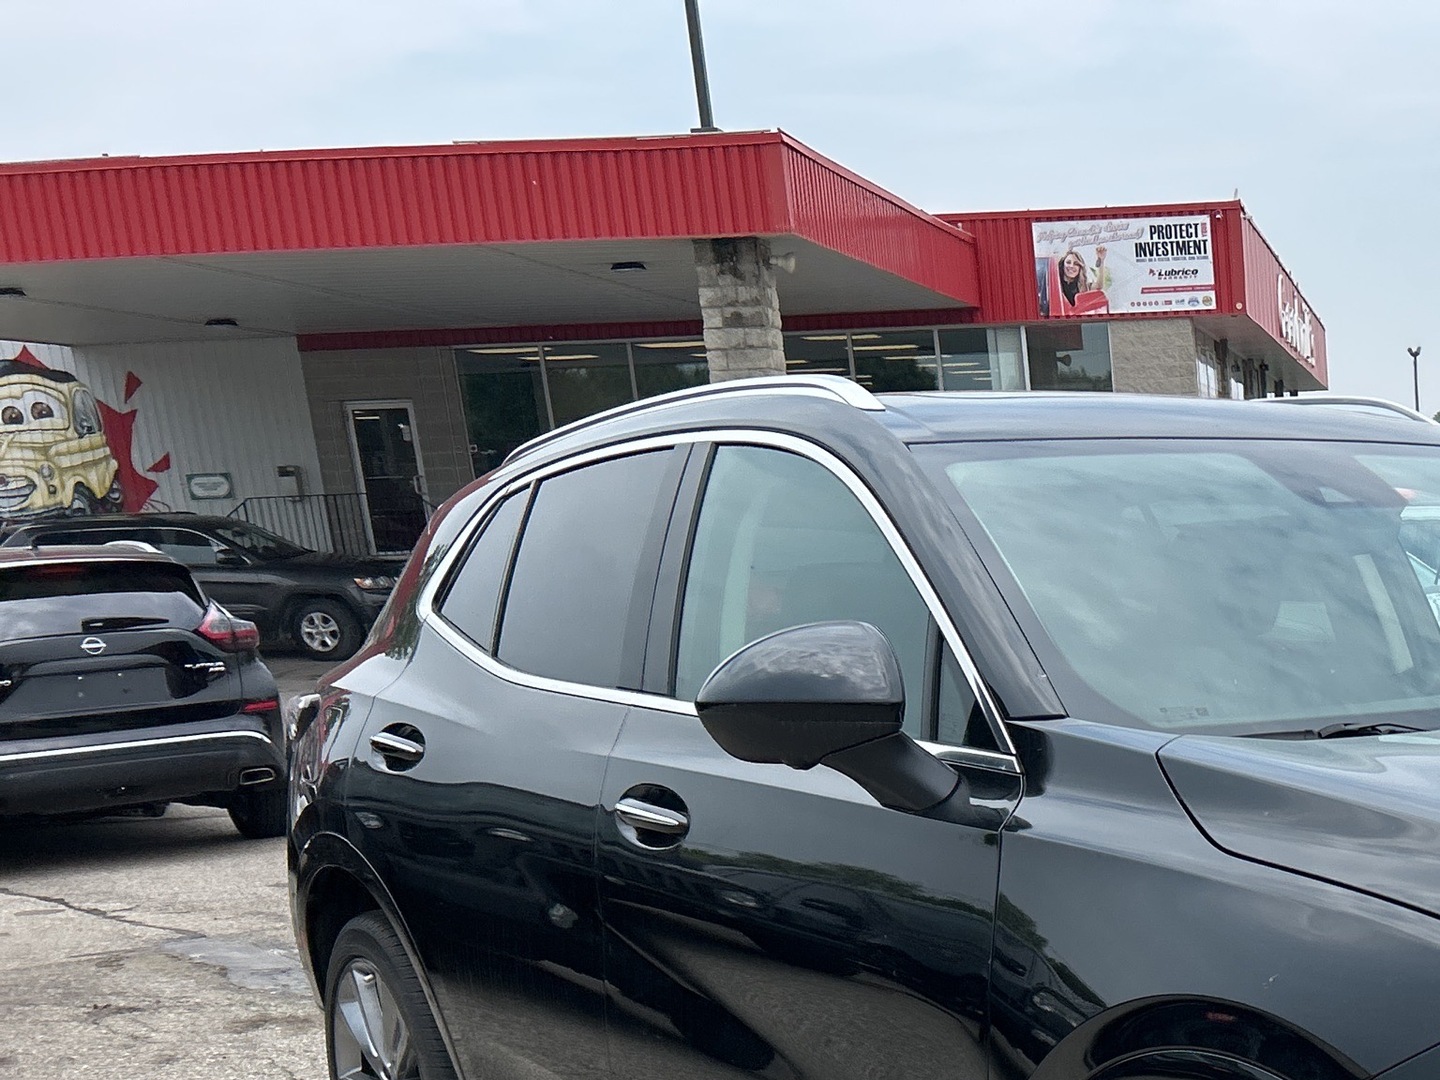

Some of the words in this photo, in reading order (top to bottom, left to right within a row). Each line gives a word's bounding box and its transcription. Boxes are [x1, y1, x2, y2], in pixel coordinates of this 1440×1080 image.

[1149, 223, 1200, 240] PROTECT
[1134, 239, 1208, 258] INVESTMENT
[1157, 268, 1199, 276] Lubrico
